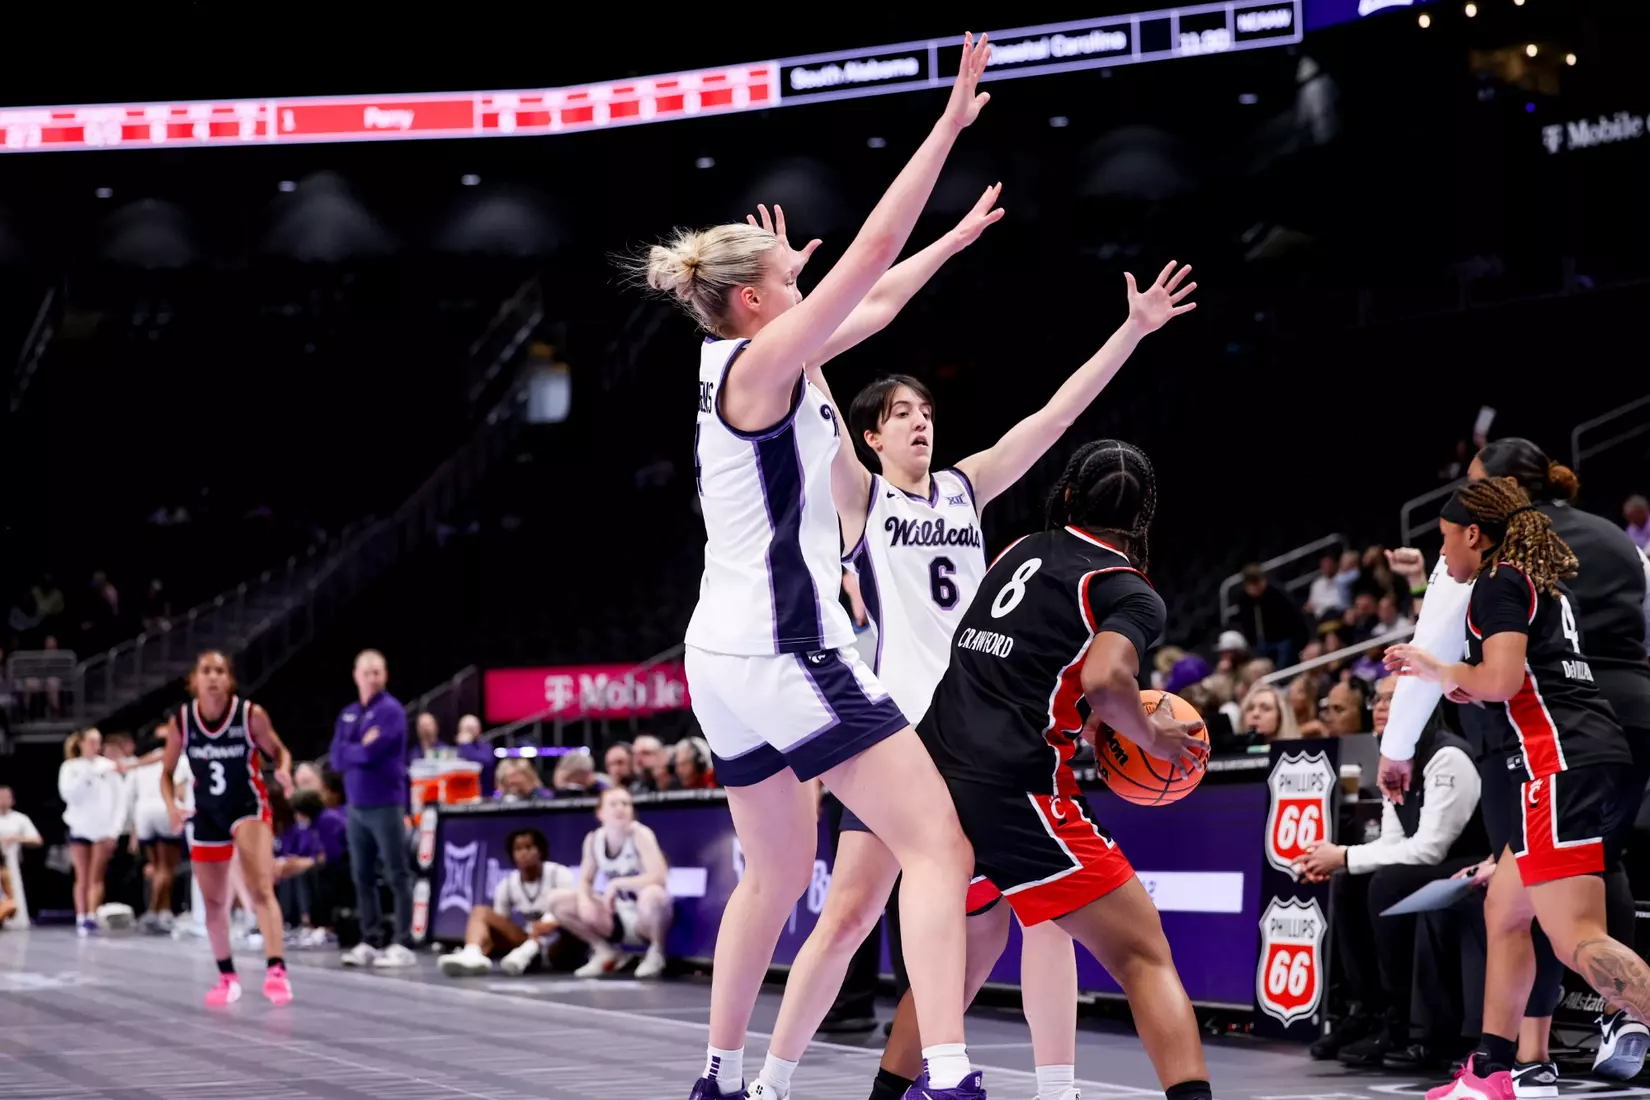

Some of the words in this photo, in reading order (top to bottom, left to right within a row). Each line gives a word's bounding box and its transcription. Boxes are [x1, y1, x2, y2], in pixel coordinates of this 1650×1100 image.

[1050, 29, 1127, 58] Carolina
[790, 63, 844, 90] South
[844, 57, 919, 83] Alabama
[363, 105, 415, 130] Perry
[1567, 110, 1644, 150] Mobile
[885, 516, 981, 550] Wildcats
[928, 556, 960, 611] 6
[991, 558, 1042, 619] 8
[1560, 594, 1581, 654] 4
[957, 627, 1014, 659] CRAWFORD
[208, 760, 227, 796] 3
[1279, 772, 1324, 792] PHILLIPS
[1277, 804, 1320, 850] 66
[1269, 918, 1316, 939] PHILLIPS
[1268, 949, 1311, 997] 66
